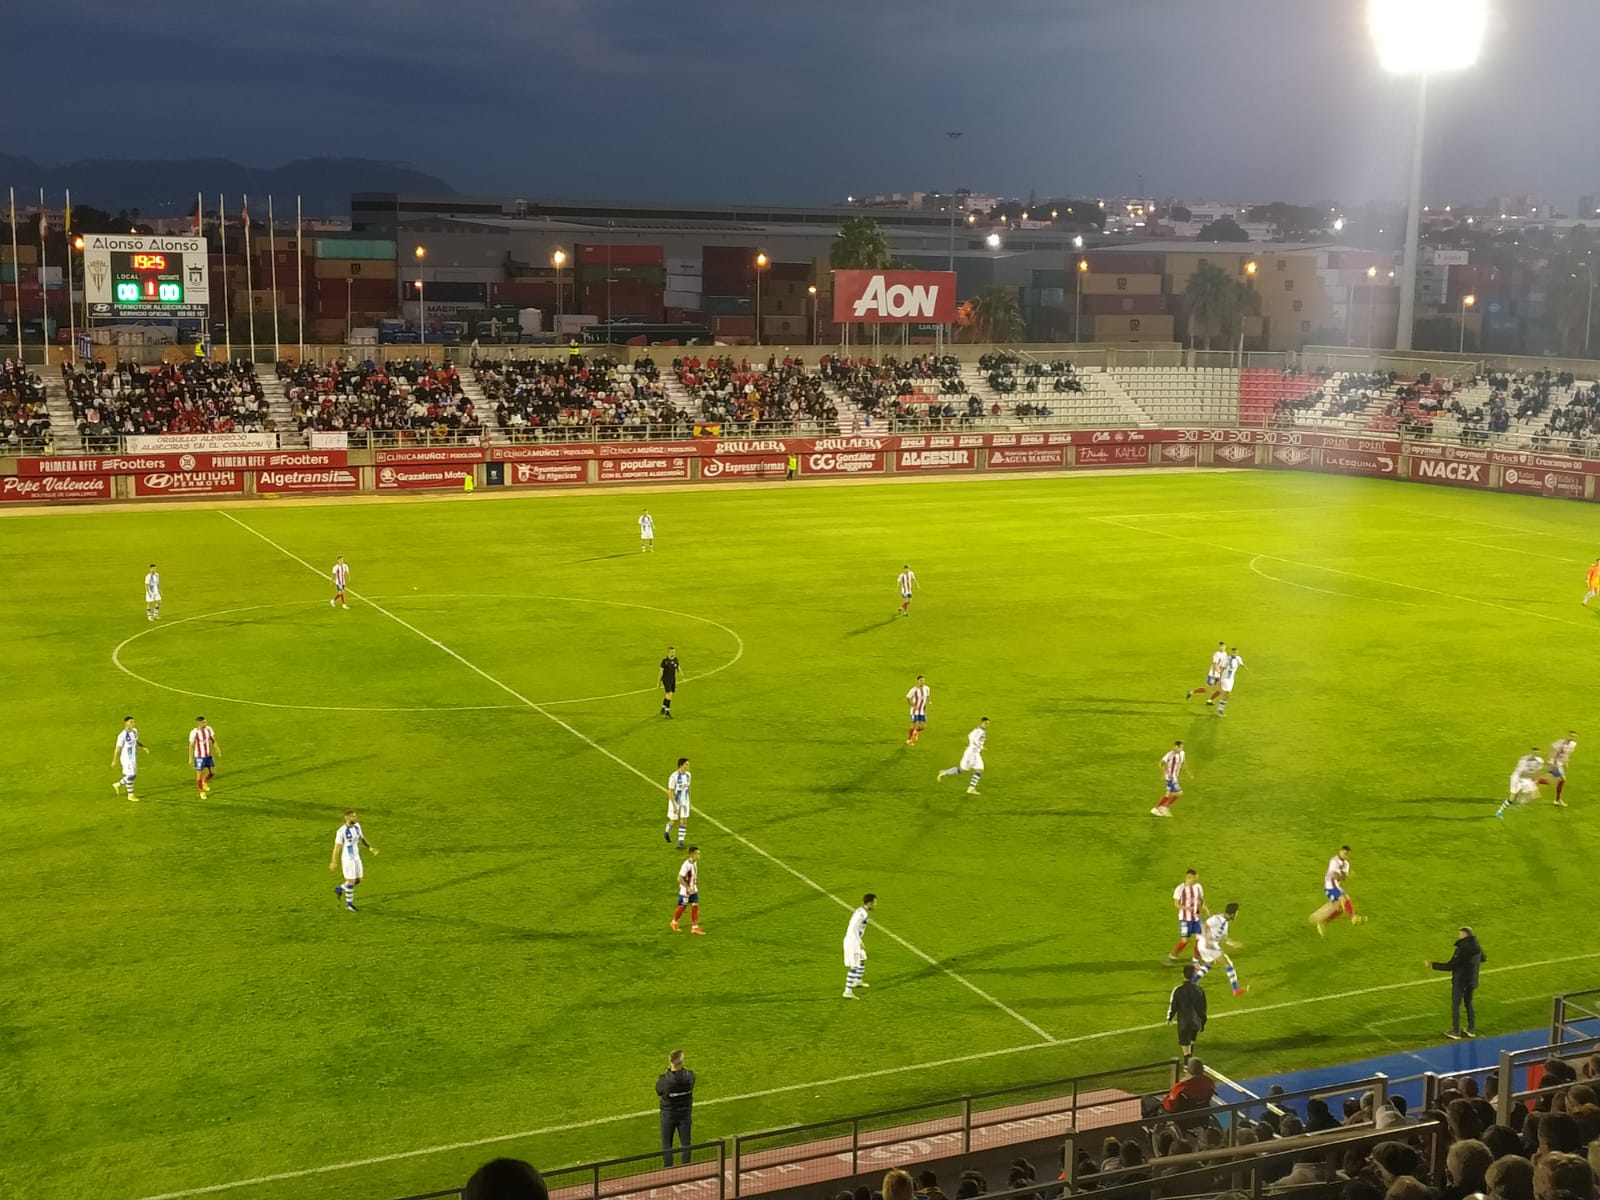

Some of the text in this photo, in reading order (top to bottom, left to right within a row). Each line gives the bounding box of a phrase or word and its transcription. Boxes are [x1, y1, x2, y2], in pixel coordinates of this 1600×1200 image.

[92, 238, 199, 251] Alonso Alonso
[118, 283, 139, 301] 00
[159, 283, 180, 301] 00
[852, 275, 939, 318] AON
[1115, 446, 1146, 458] KAHLO
[40, 460, 77, 472] PRIMERA
[113, 459, 166, 470] Footters
[212, 457, 247, 468] PRIMERA
[280, 455, 329, 465] Footters
[620, 459, 667, 471] populares
[1326, 456, 1338, 465] LA
[174, 471, 235, 481] HYUNDAI
[1418, 460, 1481, 481] NACEX
[260, 471, 338, 487] Algetransit
[4, 477, 104, 495] Pepe Valencia
